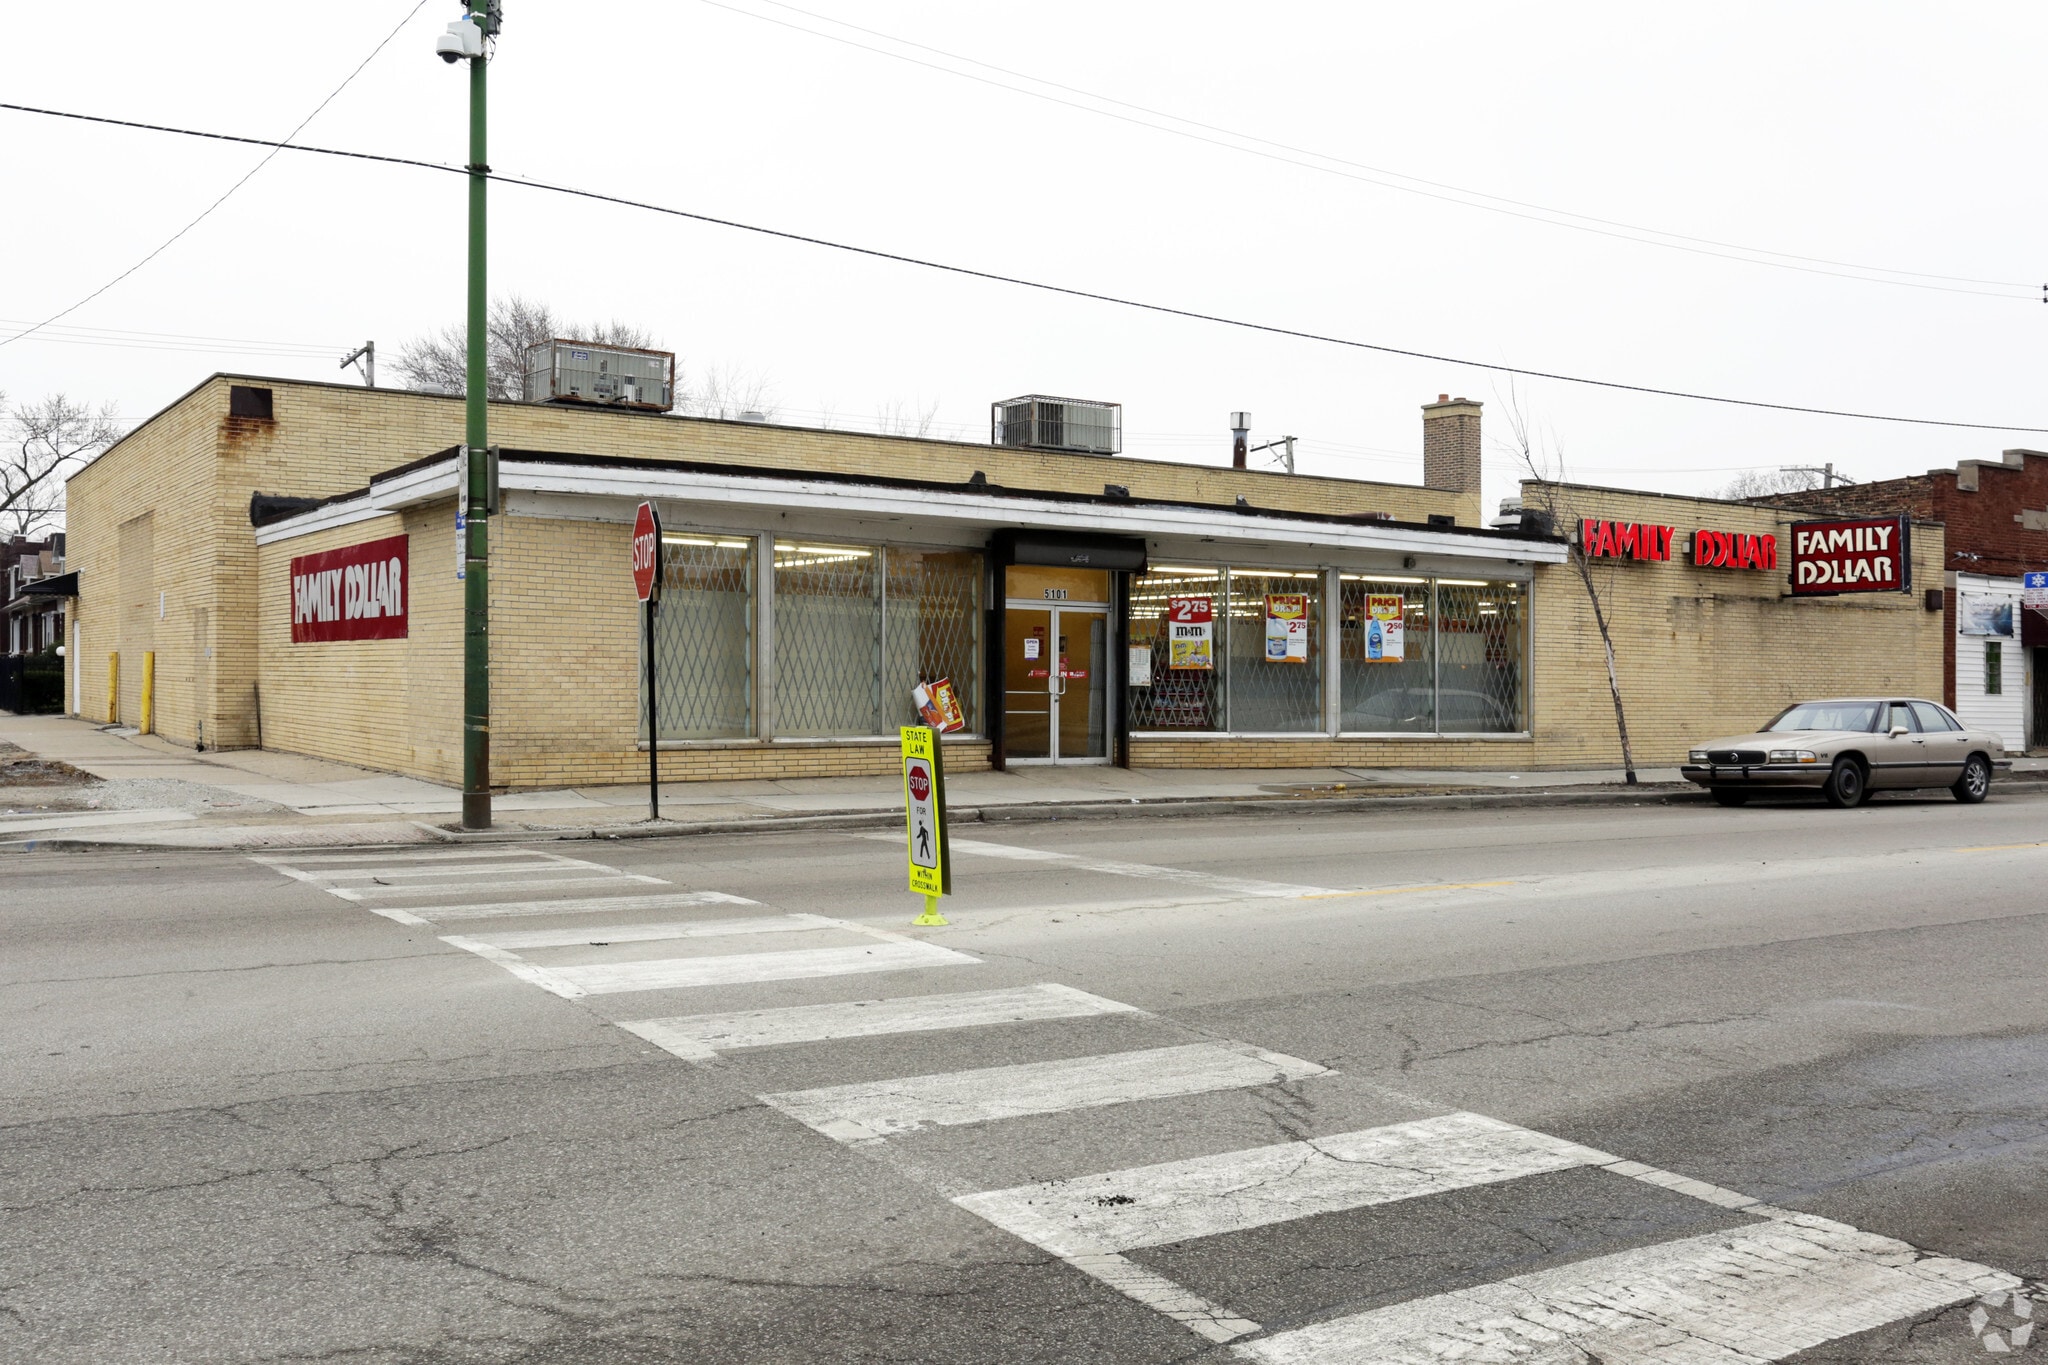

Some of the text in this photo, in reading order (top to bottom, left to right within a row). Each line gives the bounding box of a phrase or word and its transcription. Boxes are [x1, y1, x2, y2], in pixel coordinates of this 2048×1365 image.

[1584, 519, 1777, 570] FAMILY DOLLAR
[1797, 526, 1893, 555] FAMILY
[633, 533, 654, 572] STOP
[1798, 557, 1893, 585] DOLLAR
[294, 556, 402, 624] FAMILY DOLLAR
[1044, 589, 1068, 599] 5101
[1272, 596, 1300, 605] PRICE
[1372, 597, 1397, 606] PRICE
[946, 687, 961, 720] PRICE
[906, 730, 927, 742] STATE
[910, 743, 925, 755] LAW
[910, 776, 929, 791] STOP
[916, 806, 927, 815] FOR
[917, 870, 933, 880] WITHIN
[912, 880, 939, 893] CROSSWALK
